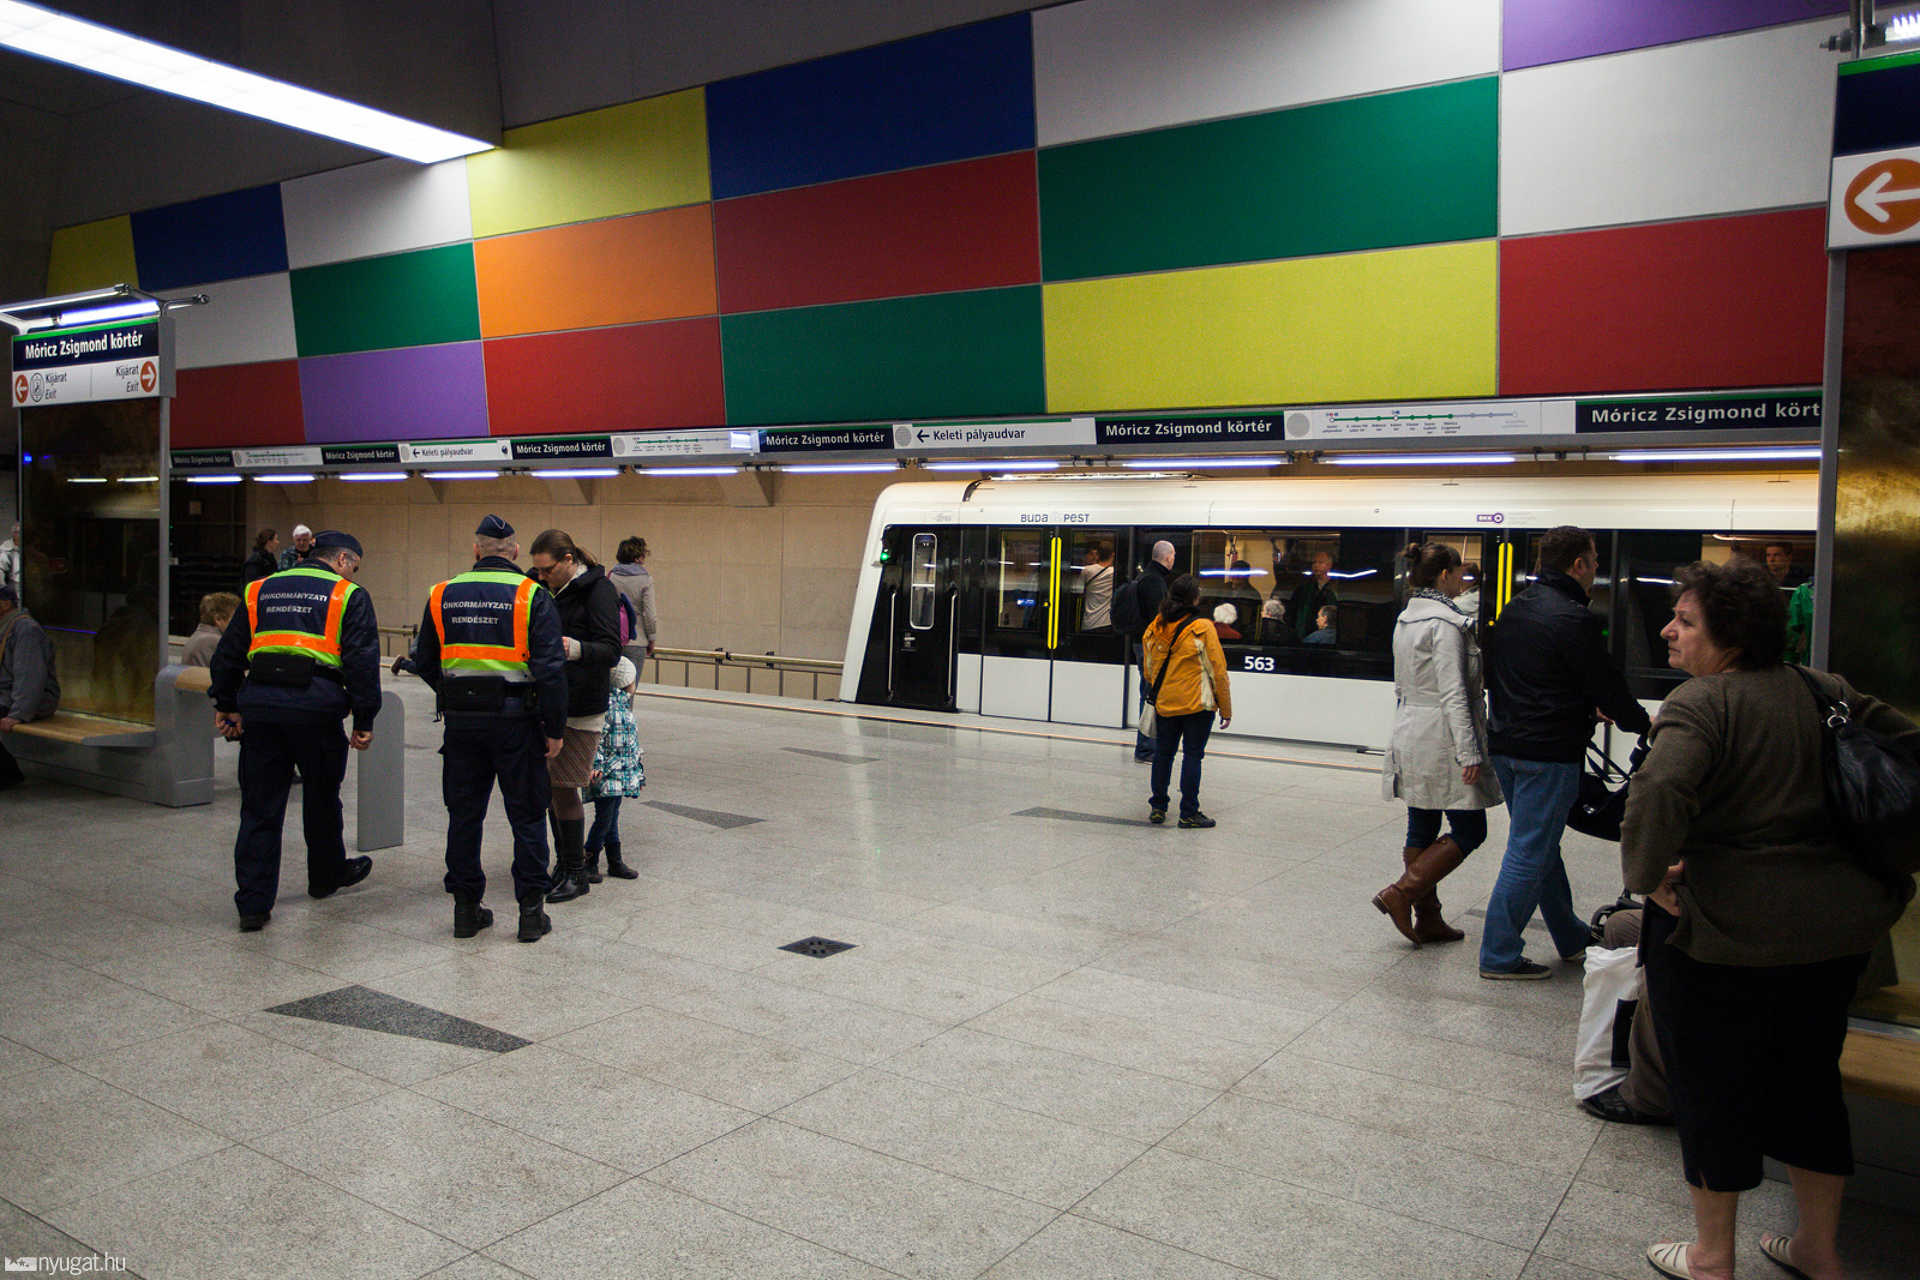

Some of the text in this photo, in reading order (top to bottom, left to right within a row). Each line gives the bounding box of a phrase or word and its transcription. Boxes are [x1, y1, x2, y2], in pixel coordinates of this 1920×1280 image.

[25, 330, 143, 359] Móricz Zsigmond körtér
[126, 381, 139, 392] Exit
[1591, 402, 1823, 424] Móricz Zsigmond kört
[933, 428, 1026, 442] Keleti pályaudvar
[1106, 419, 1272, 437] Móricz Zsigmond körtér
[766, 431, 885, 447] Móricz Zsigmond körtér
[516, 444, 541, 454] Móricz
[543, 442, 580, 455] Zsigmond
[1244, 656, 1275, 671] 563
